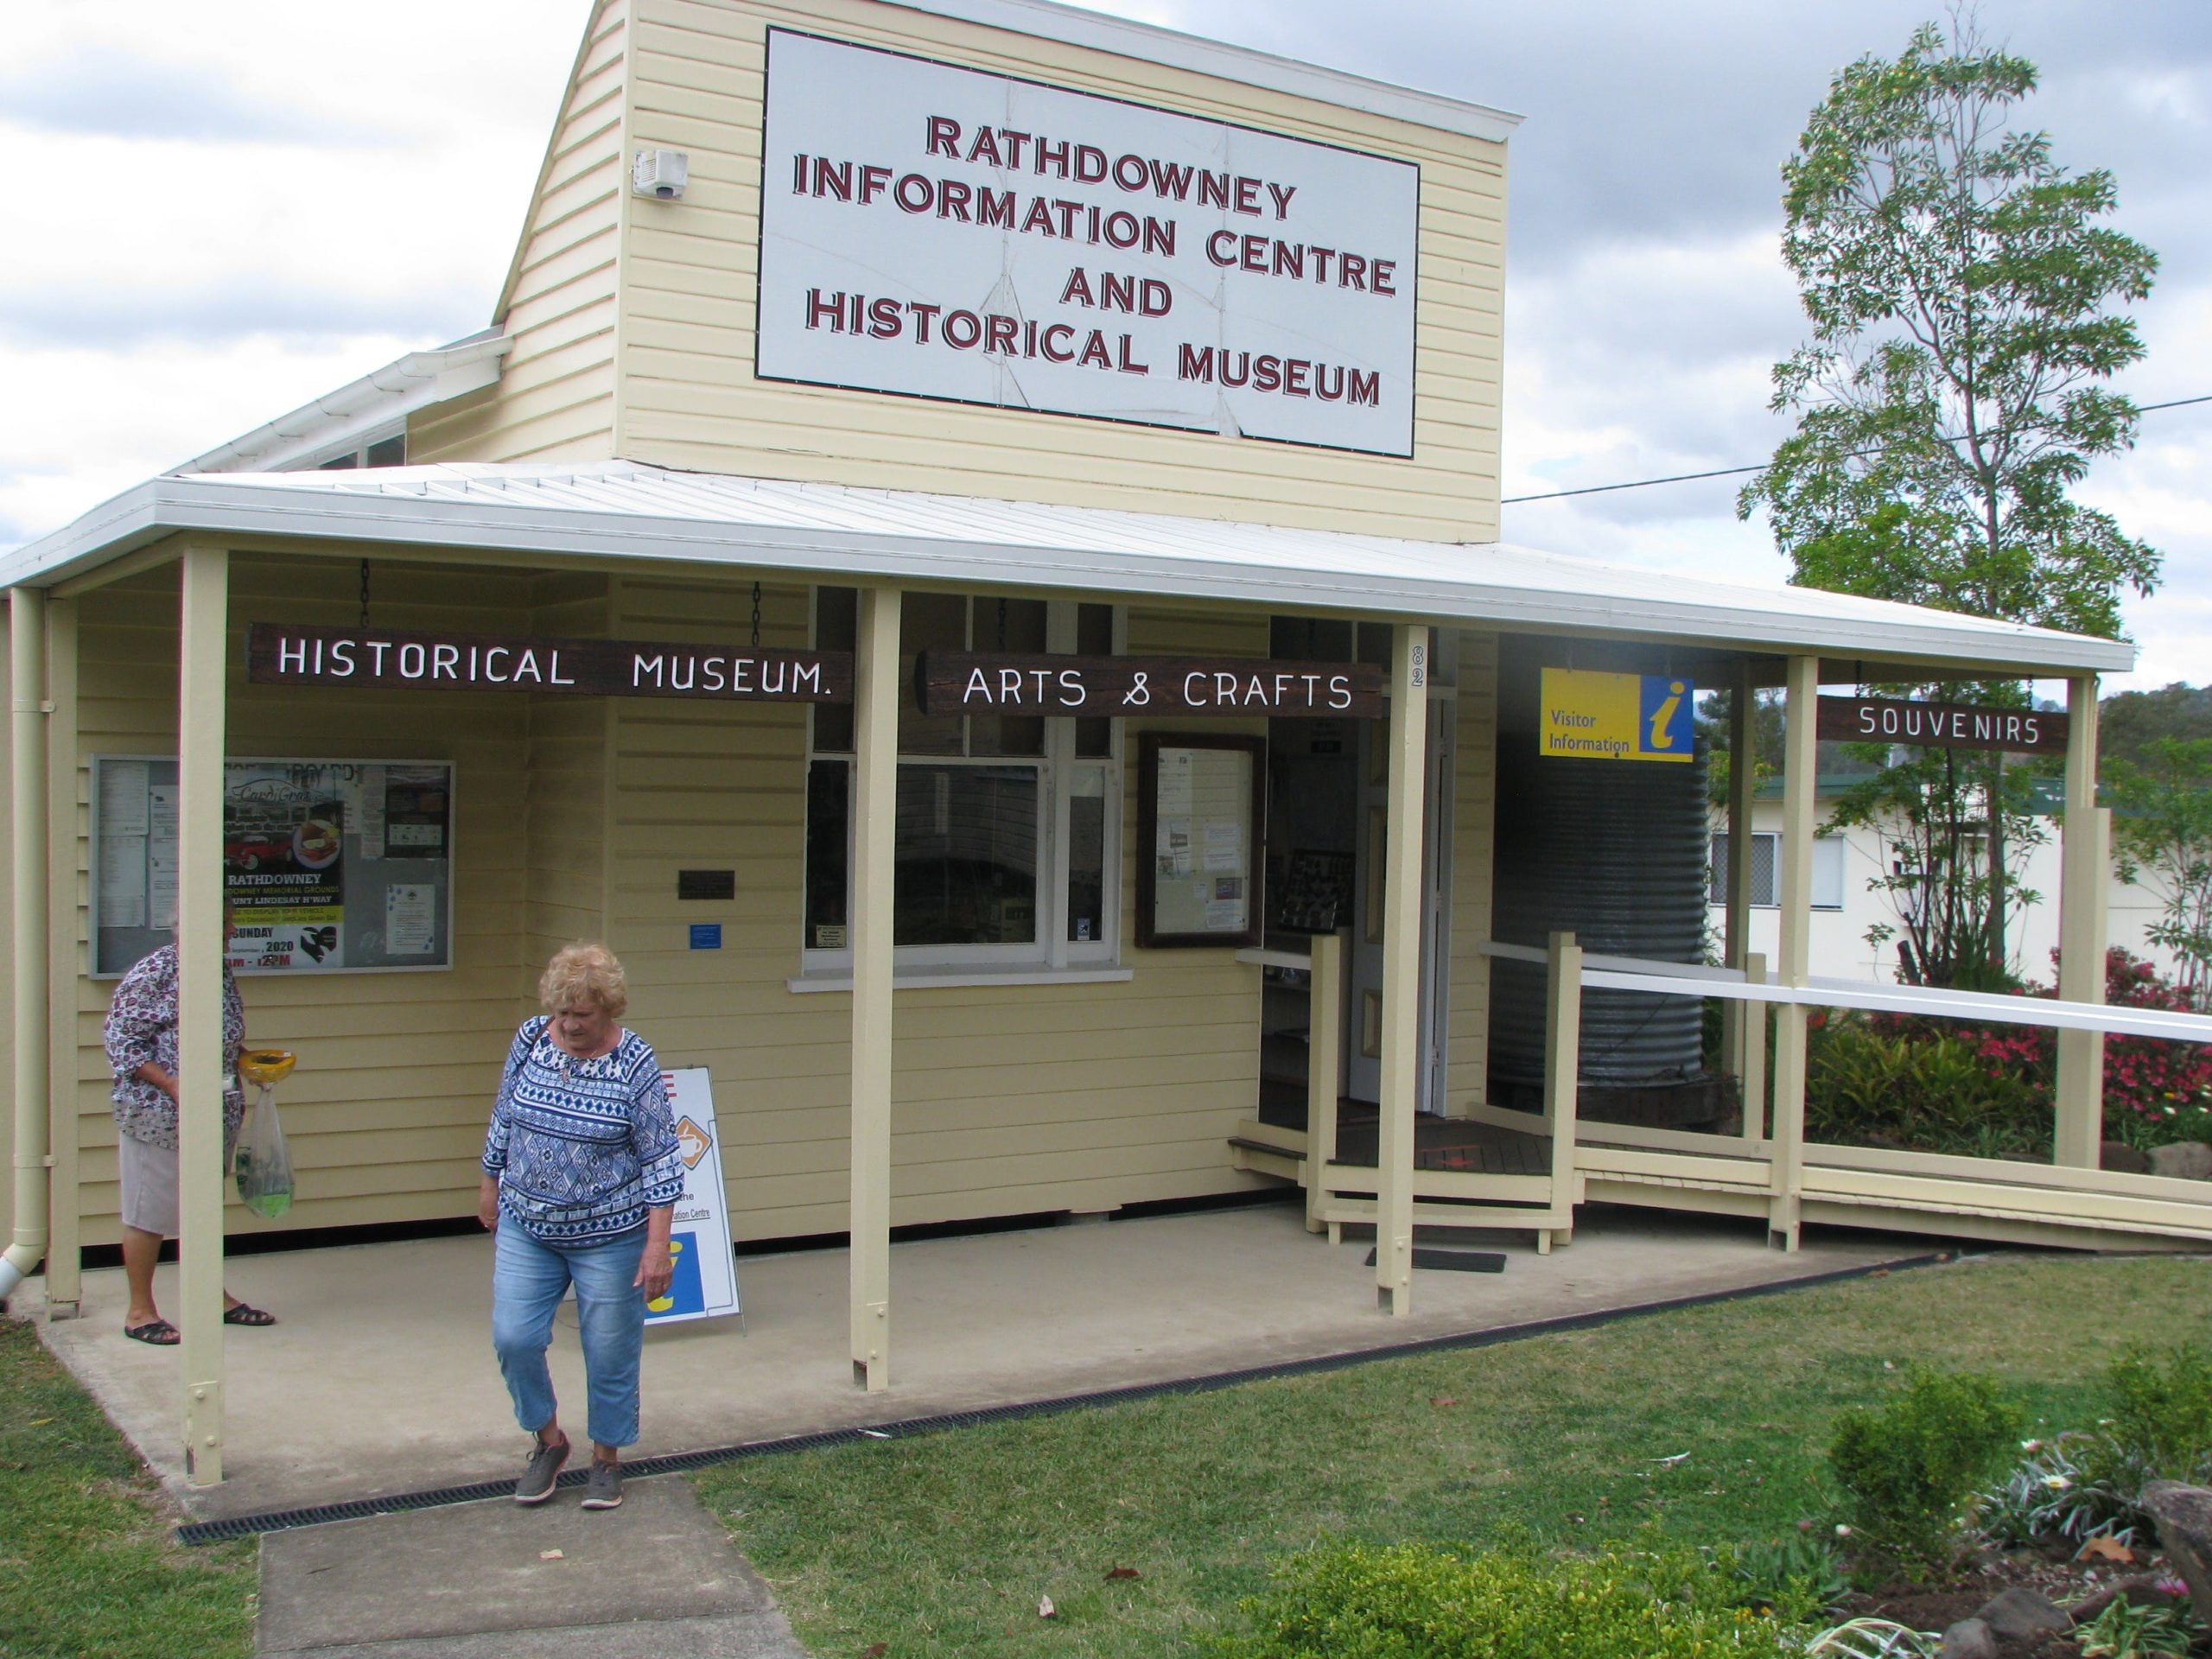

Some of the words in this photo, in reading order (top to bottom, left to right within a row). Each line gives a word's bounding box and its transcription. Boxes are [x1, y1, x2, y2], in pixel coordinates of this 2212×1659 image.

[925, 115, 1297, 221] RATHDOWNEY
[792, 153, 1176, 258] INFORMATION
[1205, 229, 1397, 297] CENTRE
[1059, 266, 1173, 318] AND
[806, 287, 1149, 377] HISTORICAL
[1179, 342, 1381, 409] MUSEUM
[278, 637, 575, 685] HISTORICAL
[632, 653, 832, 695] MUSEUM.
[963, 666, 1086, 707] ARTS
[1122, 671, 1150, 706] &
[1184, 671, 1352, 709] CRAFTS
[1550, 709, 1597, 728] Visitor
[1859, 706, 2040, 745] SOUVENIRS
[1548, 731, 1630, 753] Information
[227, 874, 321, 885] RATHDOWNEY
[232, 927, 274, 938] SUNDAY
[266, 940, 294, 952] 2020
[690, 1209, 710, 1218] Centre
